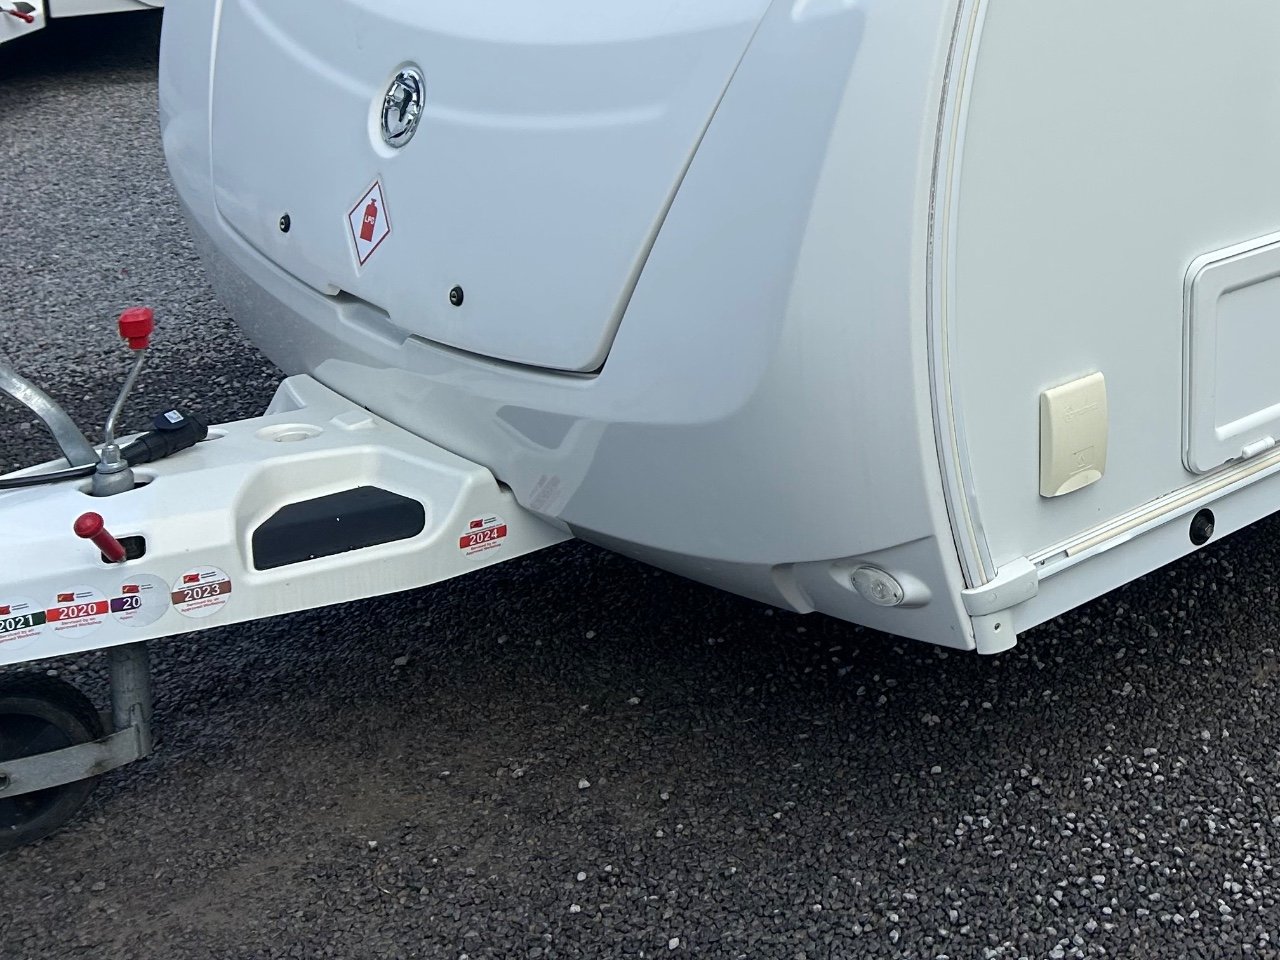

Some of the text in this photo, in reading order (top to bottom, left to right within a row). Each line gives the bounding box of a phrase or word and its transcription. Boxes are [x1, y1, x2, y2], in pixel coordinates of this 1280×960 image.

[469, 528, 498, 546] 2024
[183, 584, 220, 602] 2023
[59, 603, 97, 620] 2020
[0, 614, 34, 633] 2021
